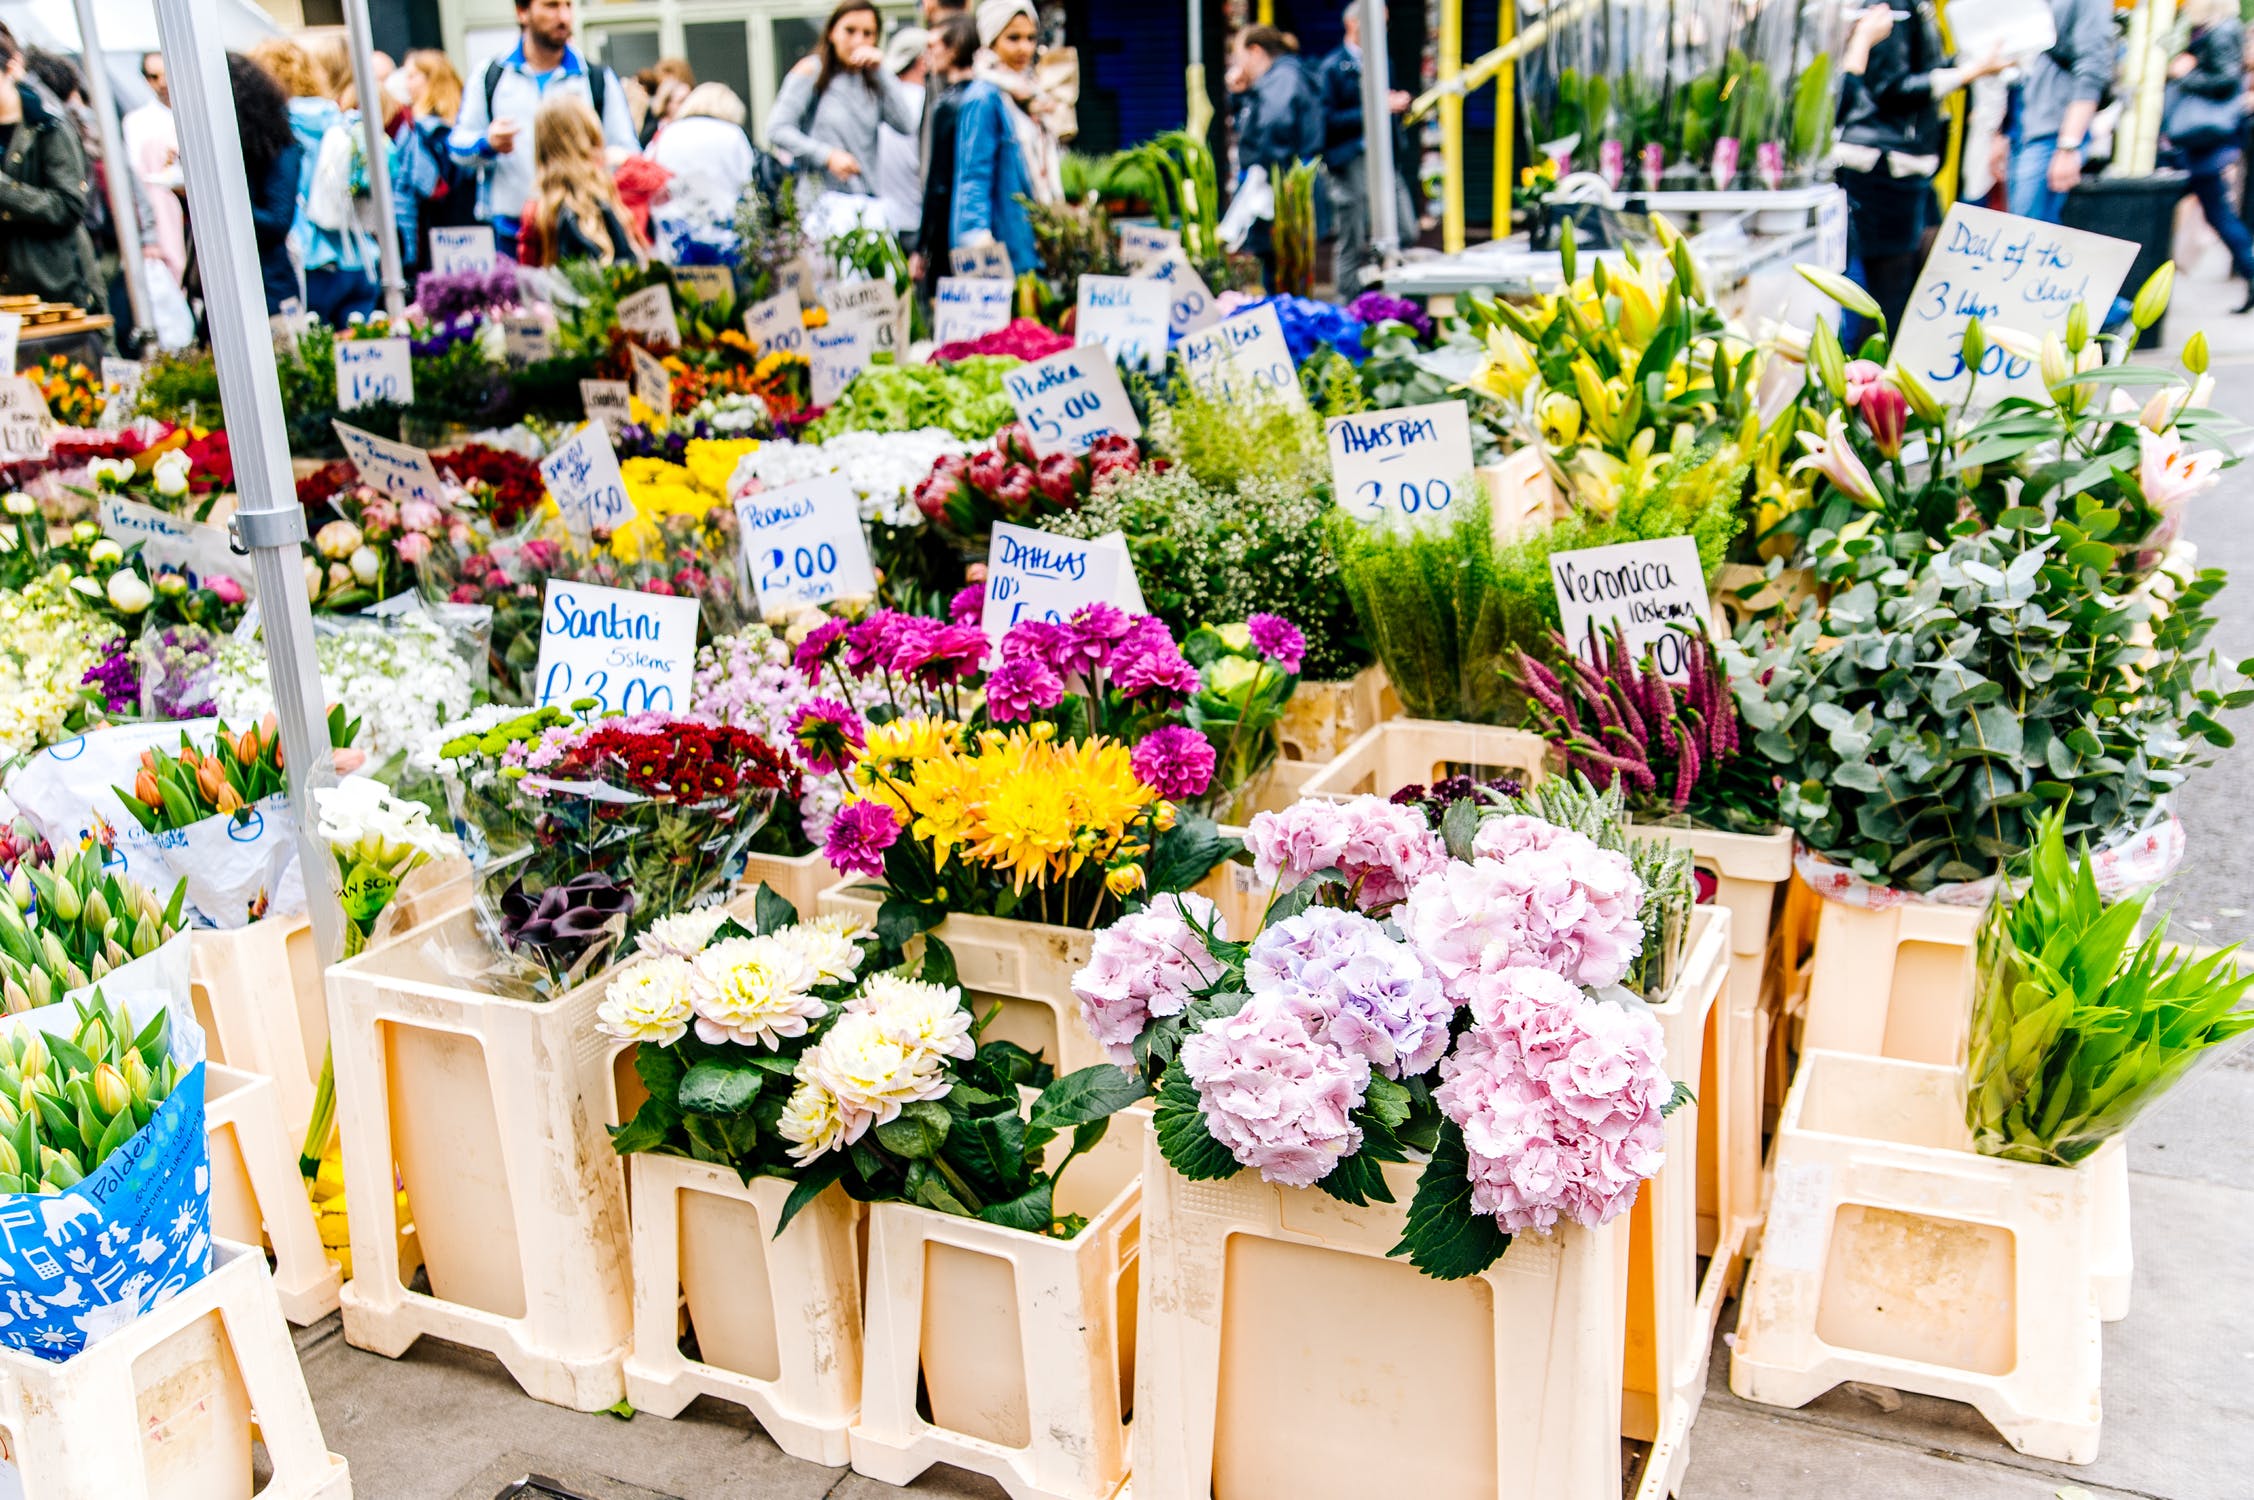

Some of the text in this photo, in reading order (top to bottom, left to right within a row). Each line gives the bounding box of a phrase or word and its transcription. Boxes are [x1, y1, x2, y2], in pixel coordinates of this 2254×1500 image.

[2003, 231, 2036, 282] of
[1917, 281, 1951, 321] 3
[1557, 561, 1678, 604] Veronica
[547, 593, 661, 641] Santini
